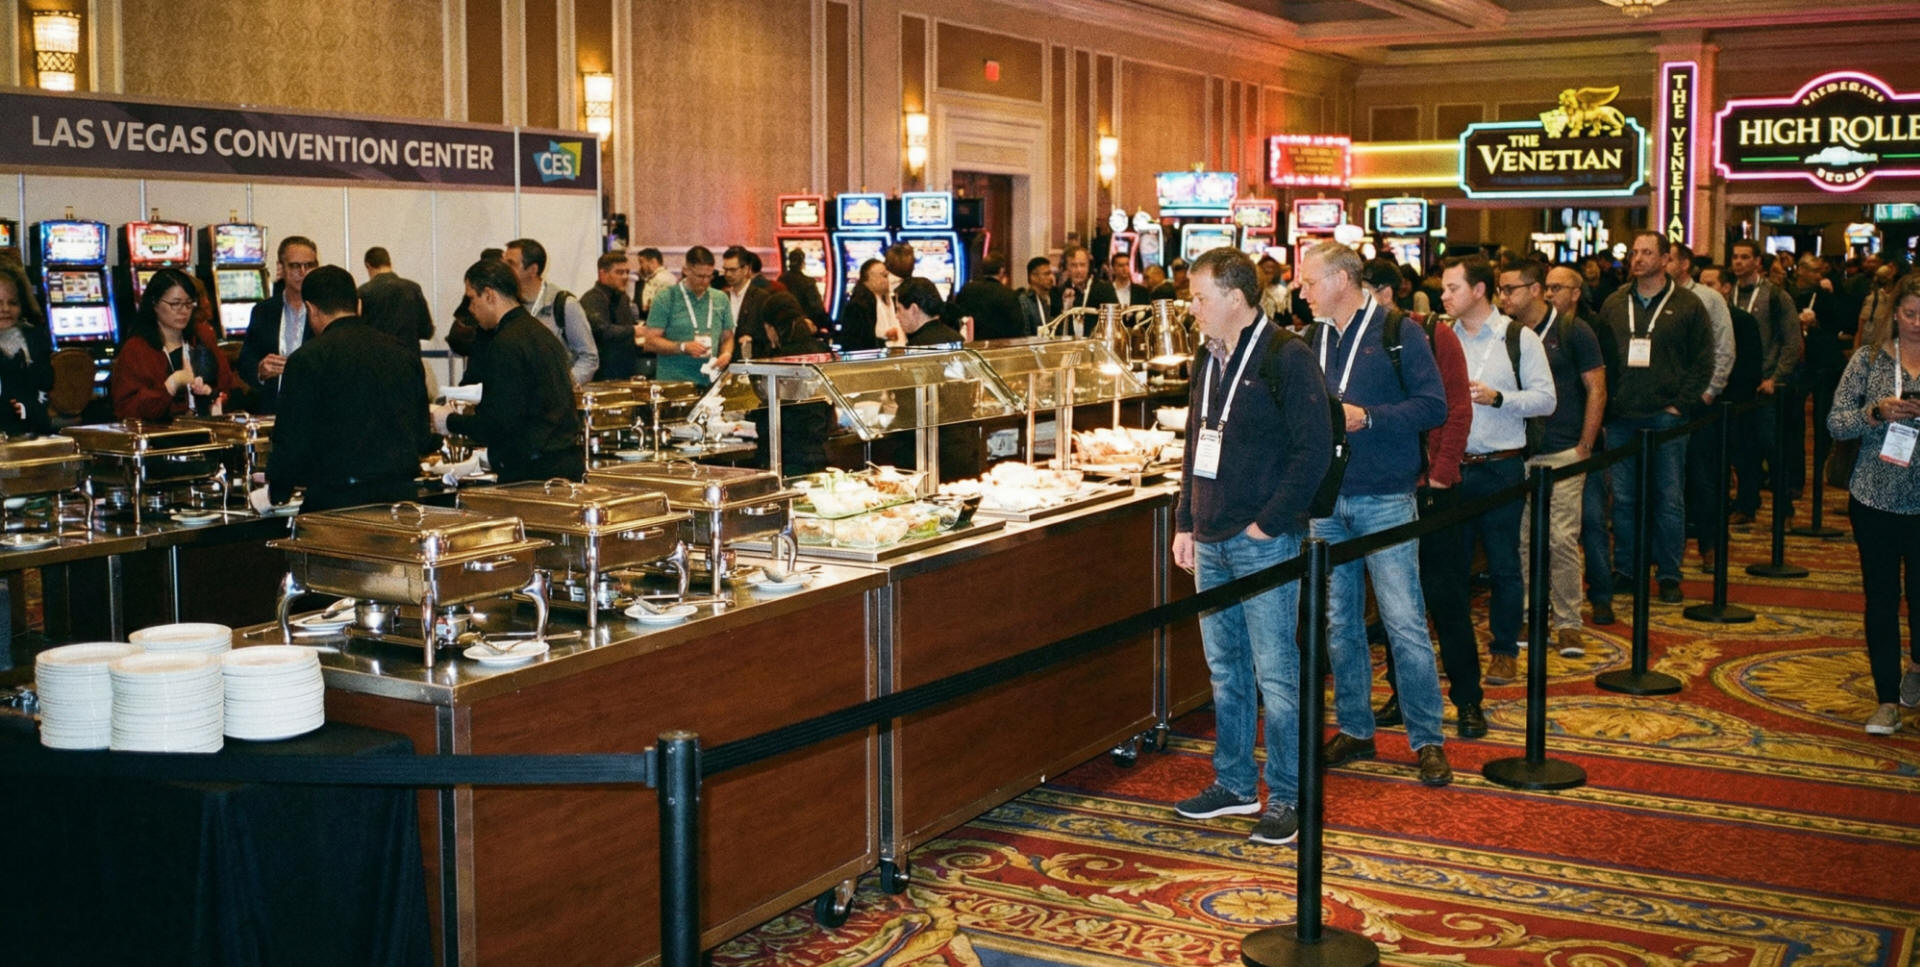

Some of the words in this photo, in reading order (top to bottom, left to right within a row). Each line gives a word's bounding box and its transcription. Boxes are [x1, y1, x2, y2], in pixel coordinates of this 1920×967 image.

[1671, 75, 1687, 119] THE
[31, 115, 95, 149] LAS
[101, 120, 207, 155] VEGAS
[213, 128, 398, 165] CONVENTION
[403, 141, 494, 171] CENTER
[1508, 135, 1540, 148] THE
[1739, 117, 1820, 145] HIGH
[539, 152, 572, 176] CES
[1477, 145, 1623, 175] VENETIAN
[1668, 127, 1687, 243] VENETIAN
